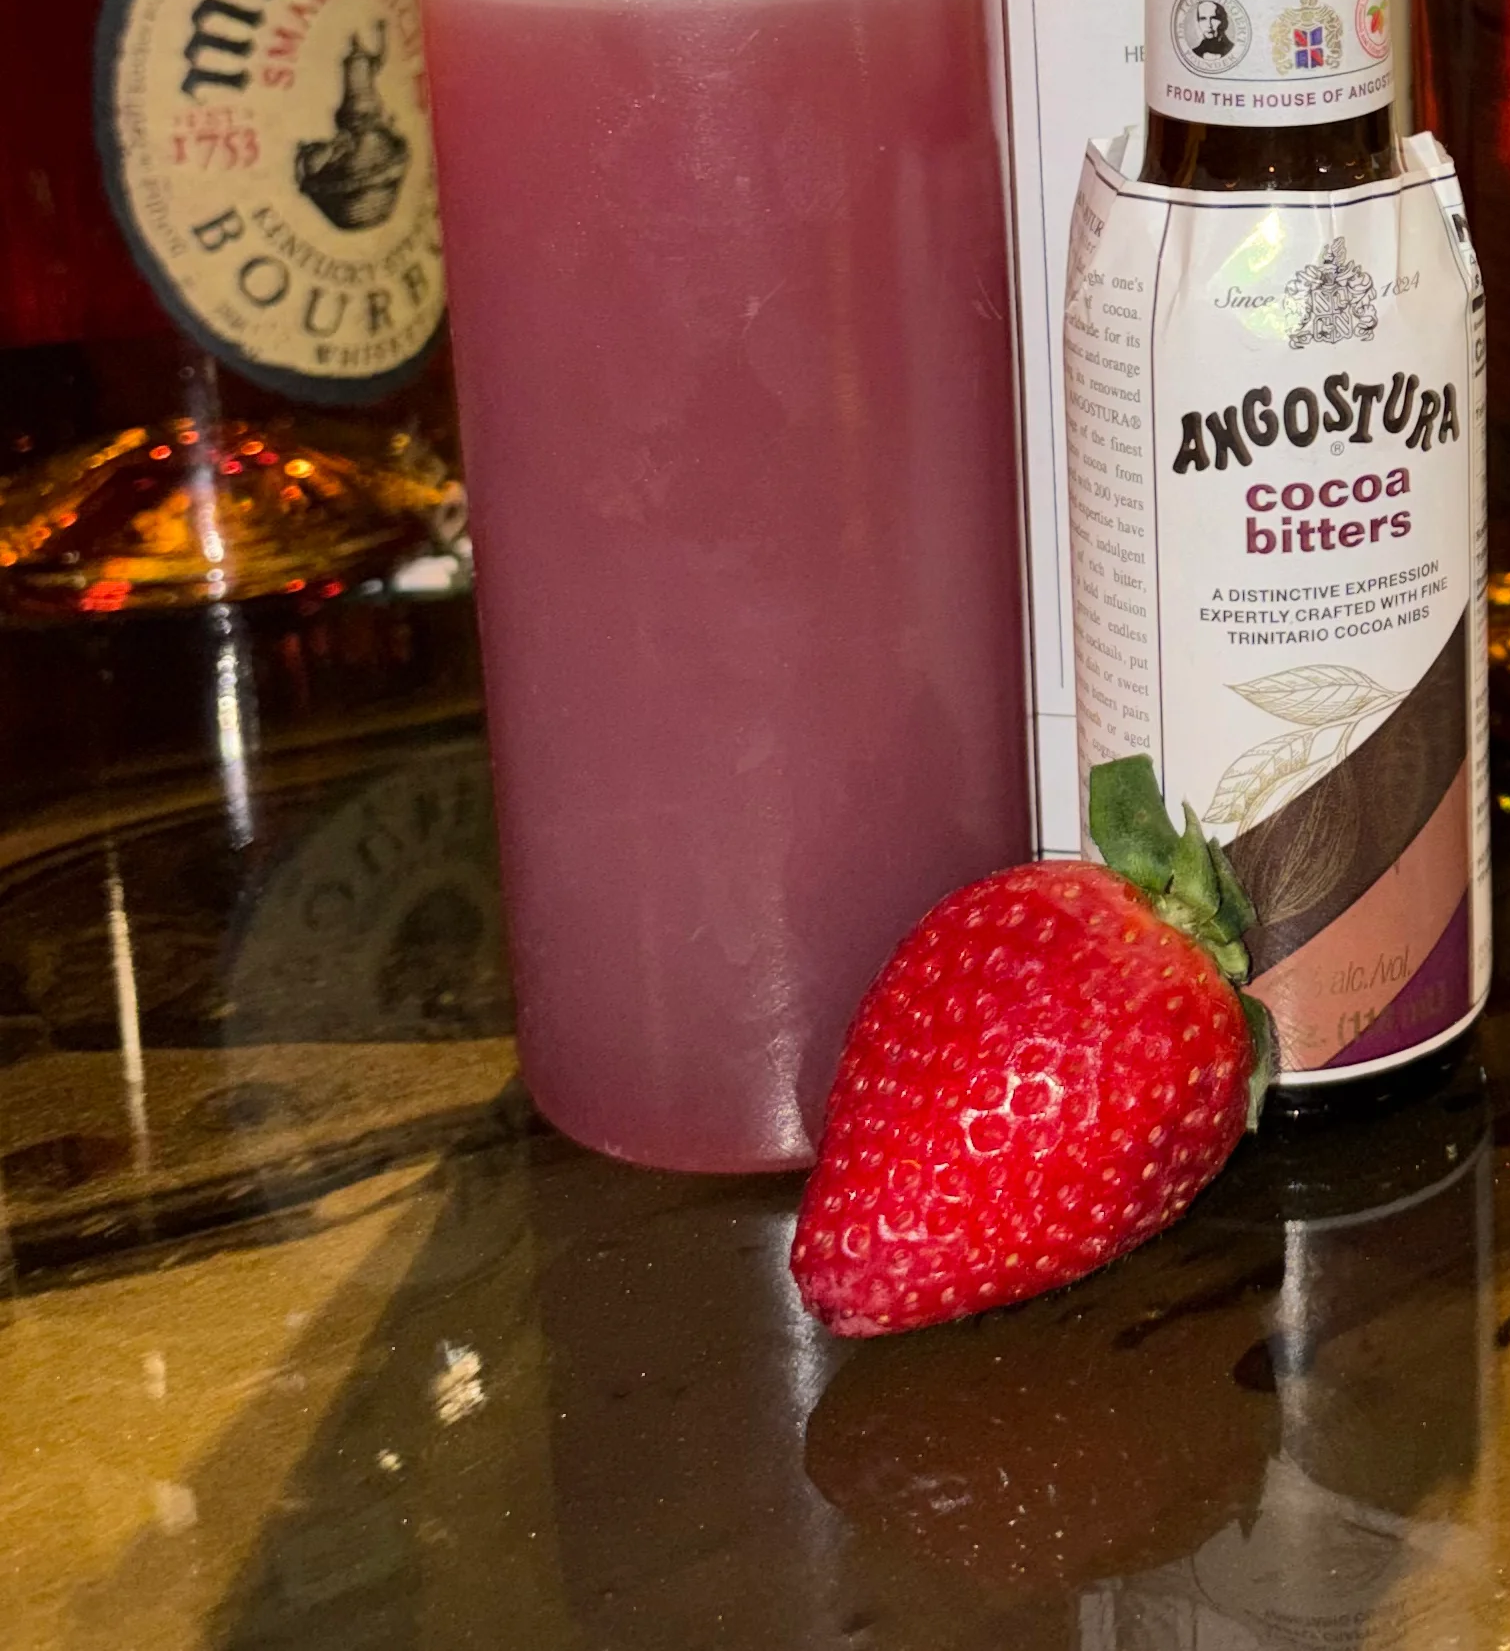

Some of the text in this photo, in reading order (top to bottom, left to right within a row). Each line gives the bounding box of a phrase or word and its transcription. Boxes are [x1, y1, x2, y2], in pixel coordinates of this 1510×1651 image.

[1166, 84, 1205, 104] FROM
[1212, 93, 1245, 107] THE
[1253, 93, 1316, 108] HOUSE
[1323, 88, 1343, 103] OF
[171, 127, 261, 171] 1753
[1111, 276, 1144, 293] one's
[1214, 271, 1421, 309] Since 1824
[1104, 326, 1121, 344] for
[1126, 331, 1141, 349] its
[1102, 356, 1141, 379] orange
[1089, 378, 1141, 404] renowned
[1172, 371, 1460, 475] ANGOSTURA
[1092, 430, 1106, 447] the
[1110, 436, 1143, 459] finest
[1115, 463, 1143, 485] from
[1094, 481, 1111, 502] 200
[1113, 492, 1144, 511] years
[1245, 467, 1411, 512] cocoa
[1117, 516, 1145, 538] have
[1245, 510, 1412, 554] bitters
[1097, 534, 1147, 564] indulgent
[1113, 566, 1148, 594] bitter,
[1212, 559, 1440, 603] A DISTINCTIVE EXPRESSION
[1104, 590, 1147, 618] infusion
[1199, 576, 1449, 624] EXPERTLY CRAFTED WITH FINE
[1107, 621, 1148, 644] endless
[1227, 605, 1431, 645] TRINITARIO COCOA NIBS
[1129, 654, 1149, 671] put
[1103, 670, 1114, 684] or
[1117, 676, 1149, 697] sweet
[1122, 704, 1150, 723] pairs
[1124, 730, 1151, 749] aged
